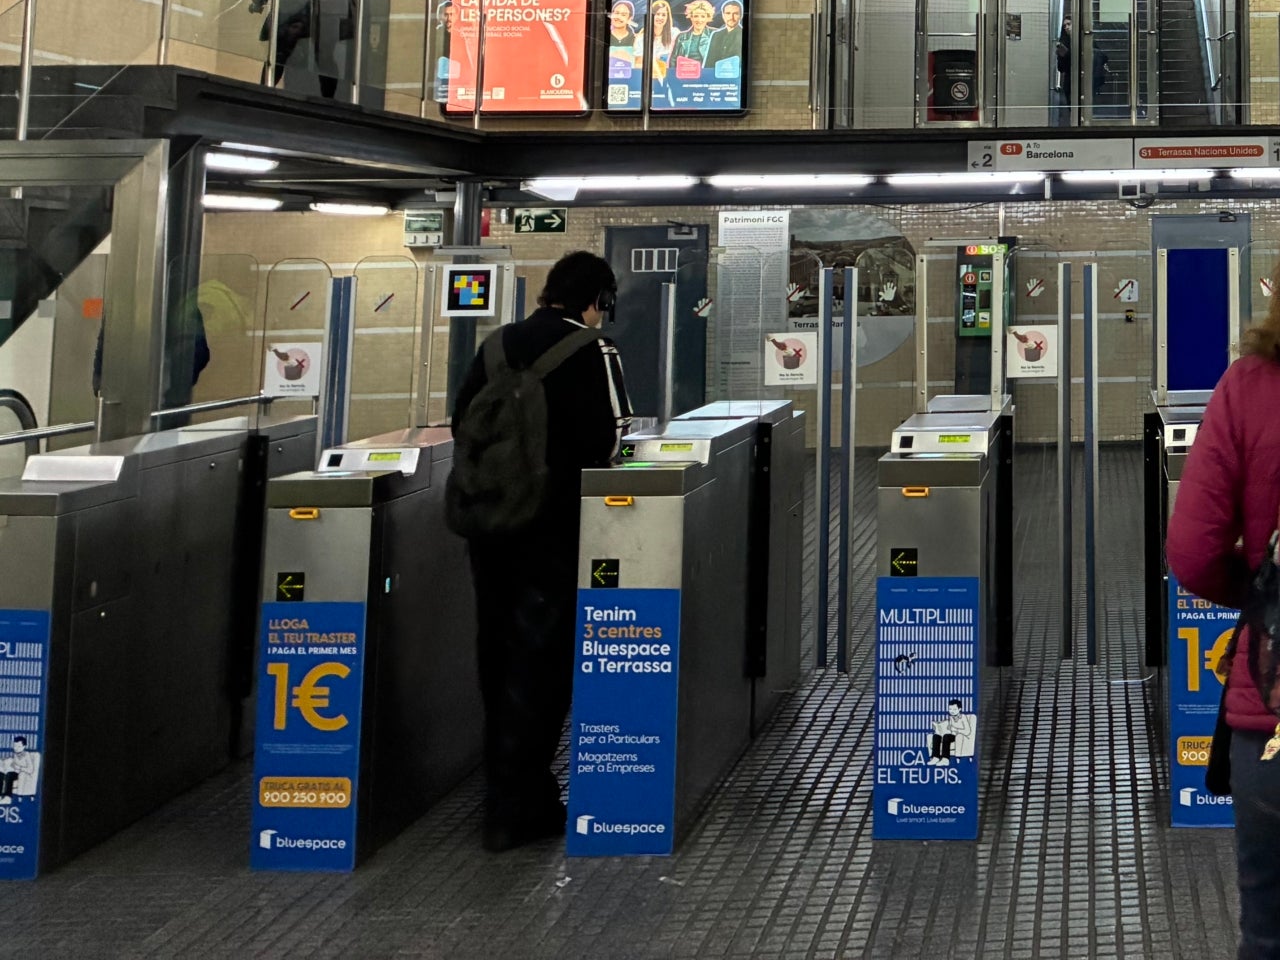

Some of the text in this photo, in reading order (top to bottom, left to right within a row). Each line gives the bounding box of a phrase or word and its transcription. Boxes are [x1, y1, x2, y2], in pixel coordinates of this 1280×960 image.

[488, 8, 571, 21] PERSONES?
[1006, 145, 1017, 153] S1
[1026, 150, 1074, 159] Barcelona
[1141, 147, 1258, 157] S1 Terrassa Nacions Unides
[1273, 148, 1280, 162] 1
[982, 153, 993, 167] 2
[724, 216, 765, 224] Patrimoni
[982, 245, 1006, 254] SOS
[584, 606, 636, 621] Tenim
[269, 619, 309, 629] LLOGA
[584, 623, 662, 638] 3 centres
[268, 633, 356, 644] EL TEU TRASTER
[272, 647, 296, 655] PAGA
[298, 647, 306, 655] EL
[308, 647, 338, 655] PRIMER
[340, 647, 357, 655] MES
[582, 640, 671, 659] Bluespace
[581, 658, 672, 673] a Terrassa
[267, 661, 351, 731] 1€
[580, 723, 620, 733] Trasters
[579, 734, 660, 746] per a Particulars
[878, 768, 962, 784] EL TEU PIS.
[263, 792, 346, 804] 900 250 900
[902, 804, 966, 816] bluespace
[593, 822, 665, 835] bluespace
[276, 837, 346, 850] bluespace
